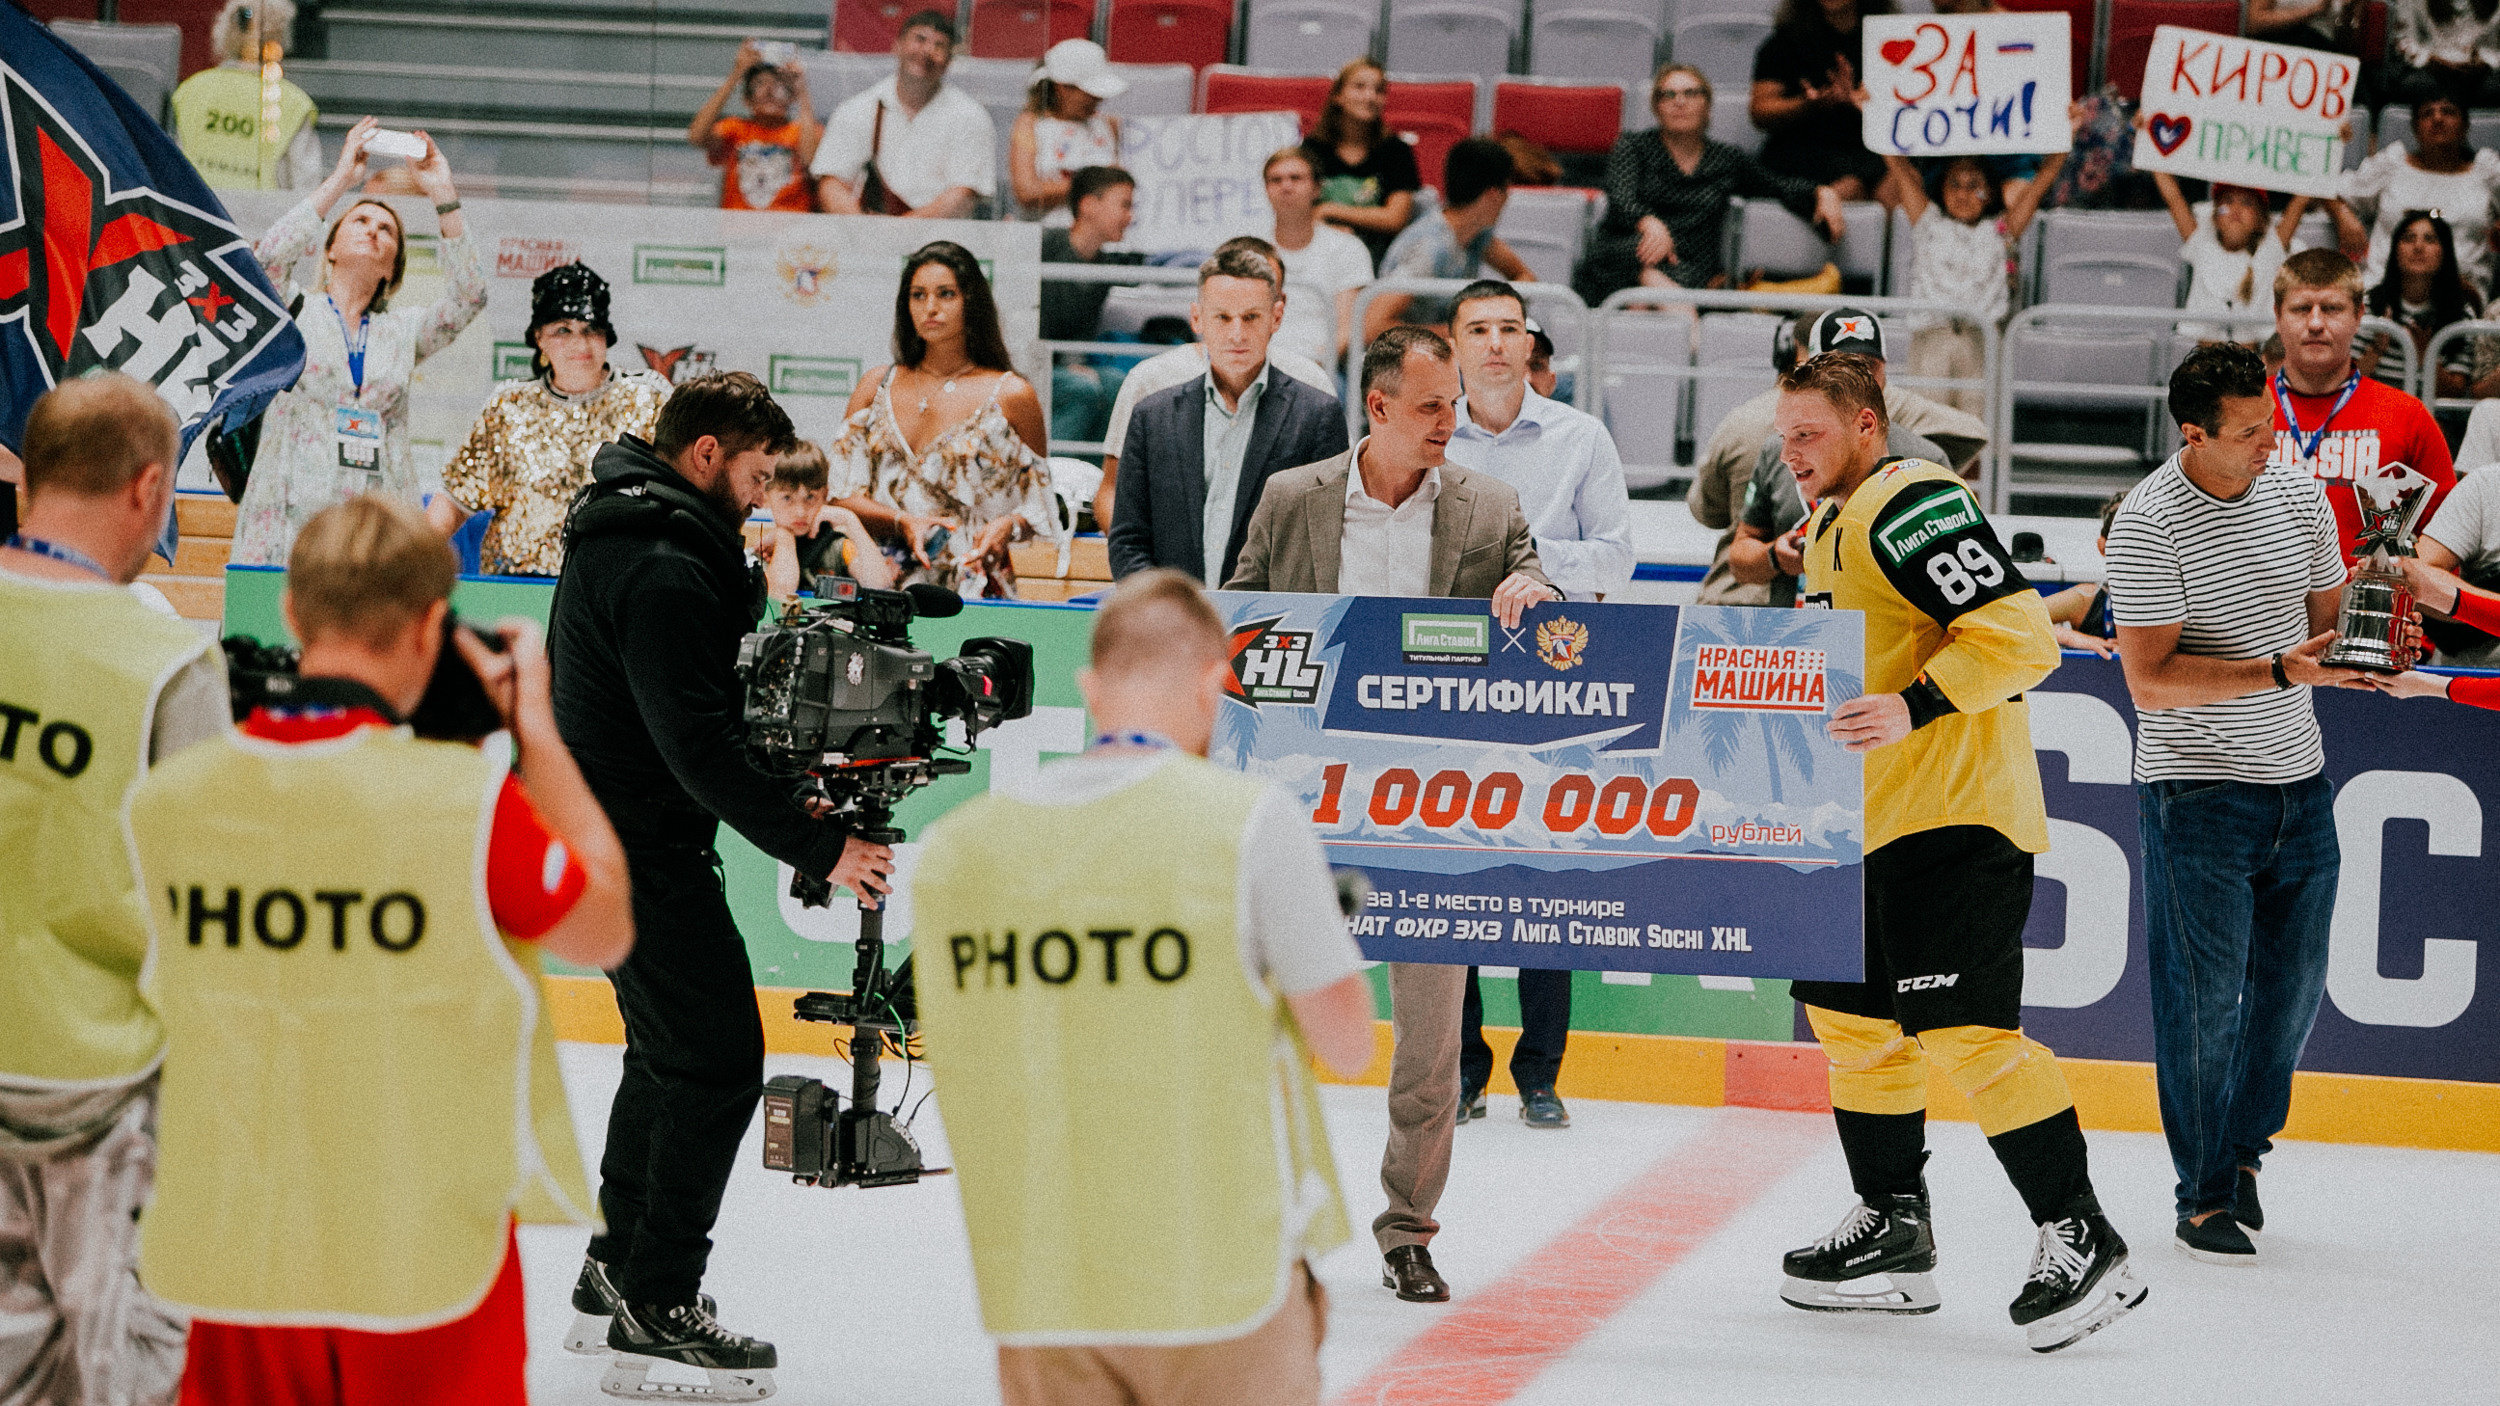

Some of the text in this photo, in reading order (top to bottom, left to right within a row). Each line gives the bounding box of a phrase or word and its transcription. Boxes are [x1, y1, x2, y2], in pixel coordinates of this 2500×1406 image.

[1893, 23, 1980, 104] ЗА
[2171, 40, 2351, 119] КИРОВ
[206, 109, 254, 137] 200
[1891, 81, 2037, 152] СОЧИ!
[2198, 119, 2341, 176] ПРИВЕТ
[1926, 538, 2004, 605] 89
[1698, 647, 1796, 669] КРАСНАЯ
[1357, 675, 1635, 717] СЕРТИФИКАТ
[1694, 670, 1824, 702] МАШИНА
[1312, 763, 1803, 848] 1 000 000 рублей
[1366, 890, 1625, 918] за 1-е место в турнире
[950, 927, 1191, 990] PHOTO
[1394, 917, 1449, 939] ФХР
[1512, 919, 1561, 943] ЛИГА
[1568, 920, 1641, 947] СТАВОК
[1711, 926, 1753, 951] XHL
[1897, 973, 1960, 993] CCM
